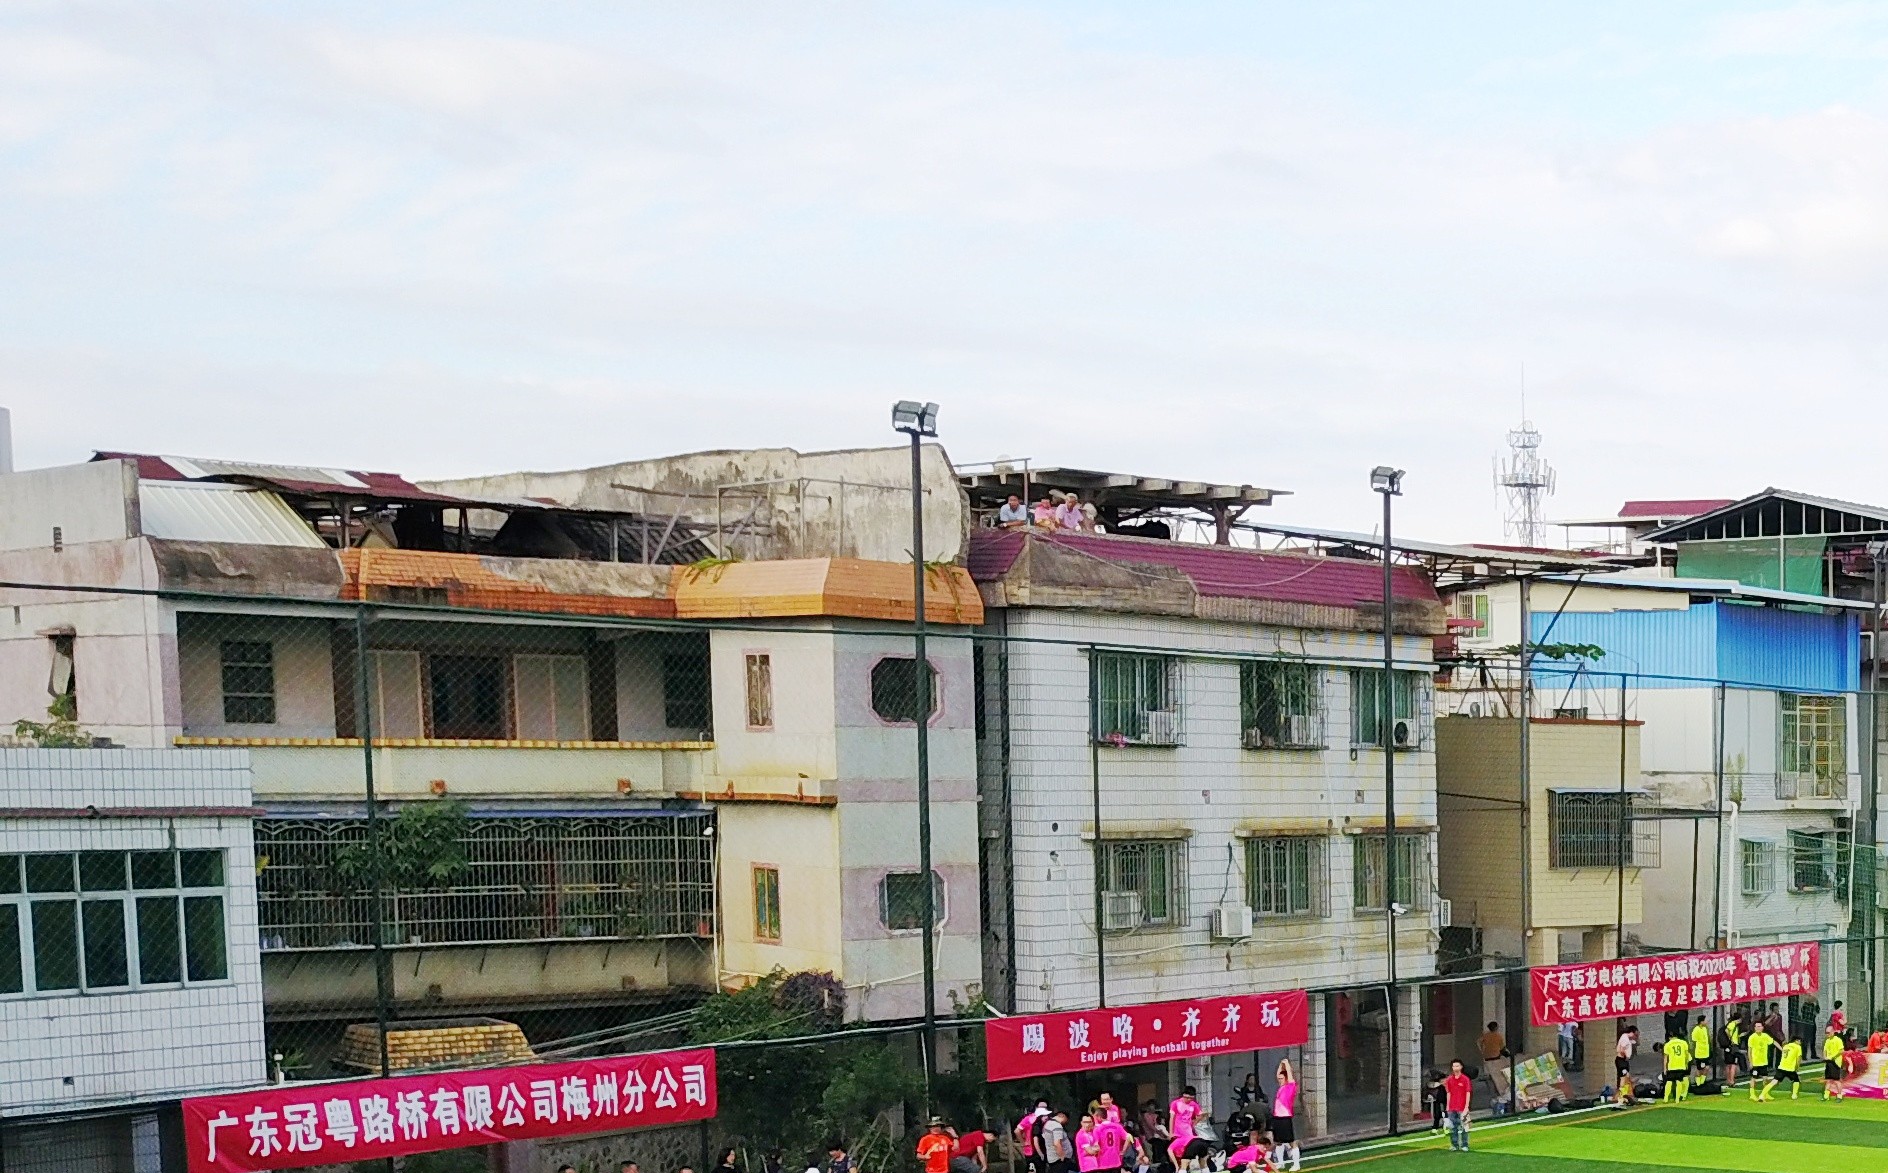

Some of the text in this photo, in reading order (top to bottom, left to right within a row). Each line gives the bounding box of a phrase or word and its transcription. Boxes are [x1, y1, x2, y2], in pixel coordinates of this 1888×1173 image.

[1080, 1036, 1230, 1063] Enjoy playing football together
[206, 1065, 708, 1164] 广东冠粤路桥有限公司梅州分公司
[1106, 1131, 1114, 1147] 8
